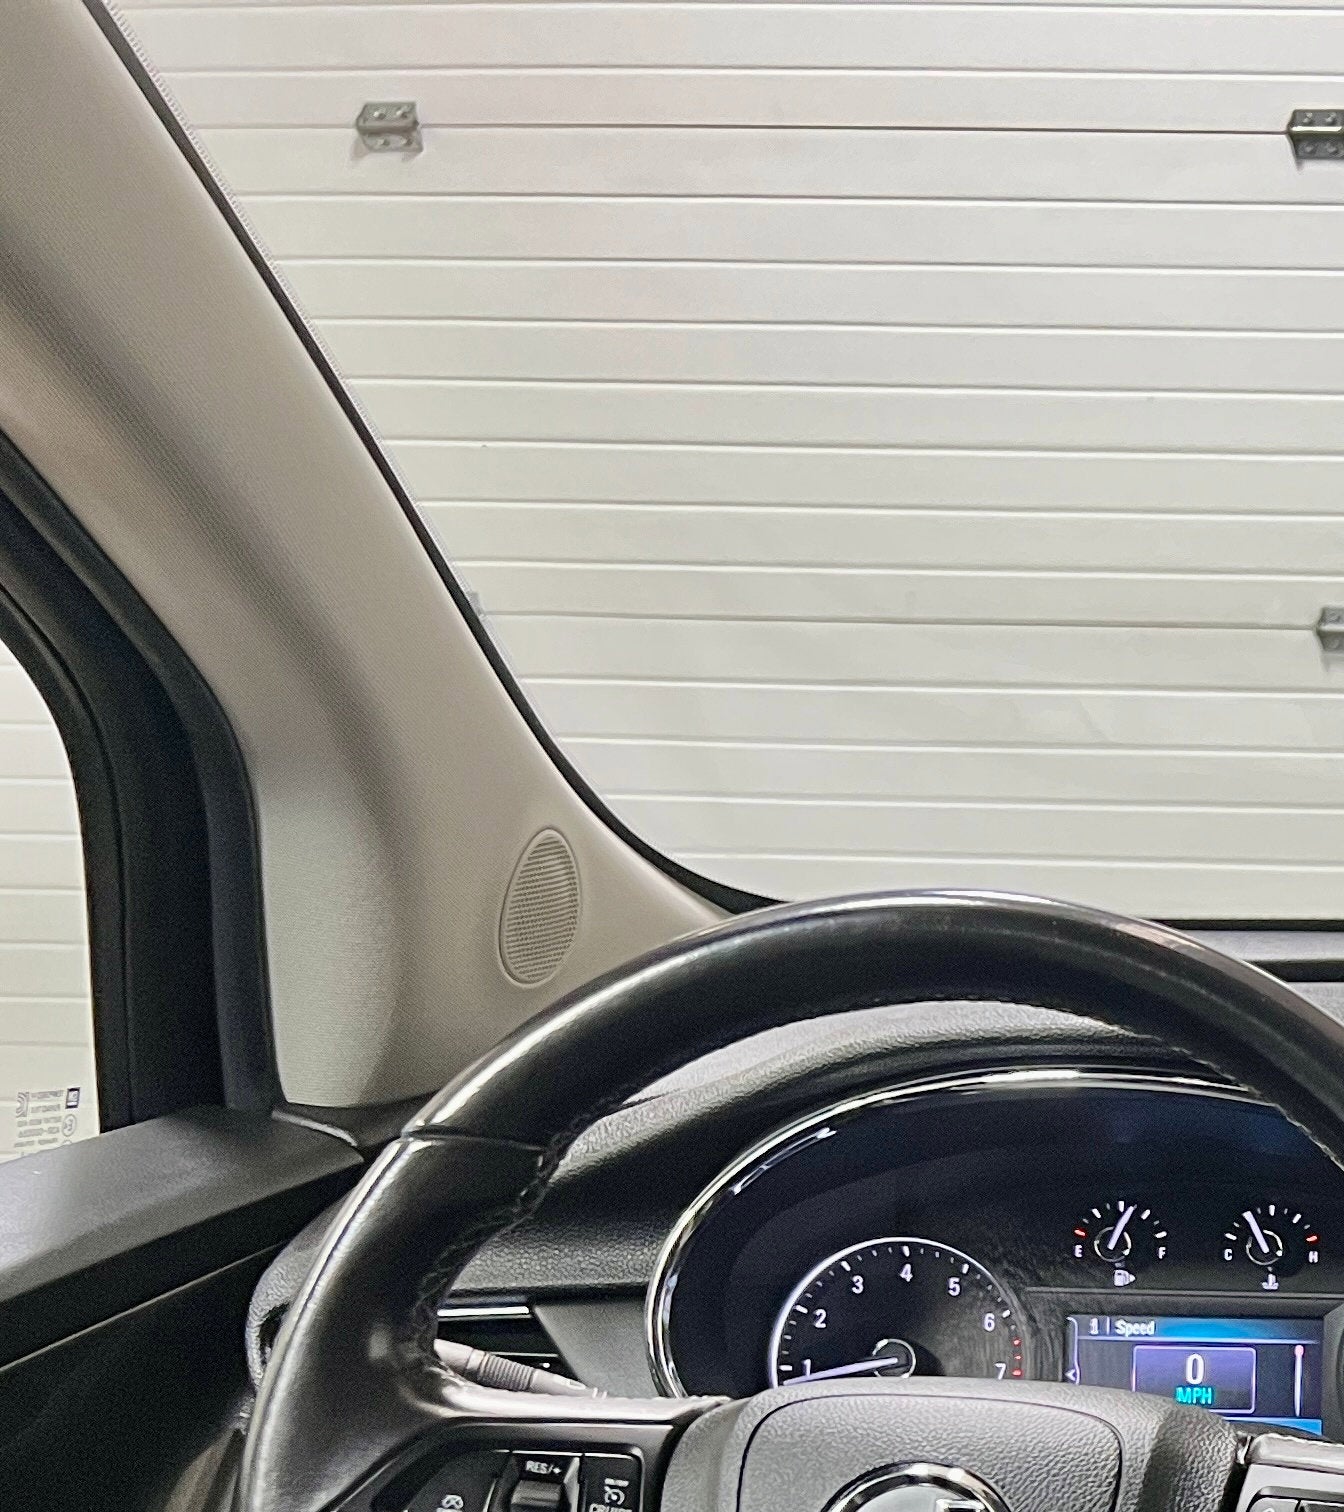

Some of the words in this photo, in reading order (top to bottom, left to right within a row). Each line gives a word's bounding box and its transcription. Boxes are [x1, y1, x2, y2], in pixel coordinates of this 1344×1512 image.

[1074, 1244, 1083, 1258] E
[1158, 1246, 1167, 1259] F
[1224, 1248, 1233, 1261] C
[1308, 1251, 1319, 1263] H
[900, 1263, 914, 1282] 4
[851, 1274, 864, 1294] 3
[948, 1276, 961, 1296] 5
[814, 1308, 827, 1329] 2
[983, 1312, 995, 1332] 6
[1089, 1317, 1099, 1335] 1
[1114, 1319, 1155, 1338] Speed
[803, 1358, 812, 1376] 1
[994, 1362, 1007, 1380] 7
[1185, 1353, 1205, 1385] 0
[1175, 1386, 1213, 1405] MPH
